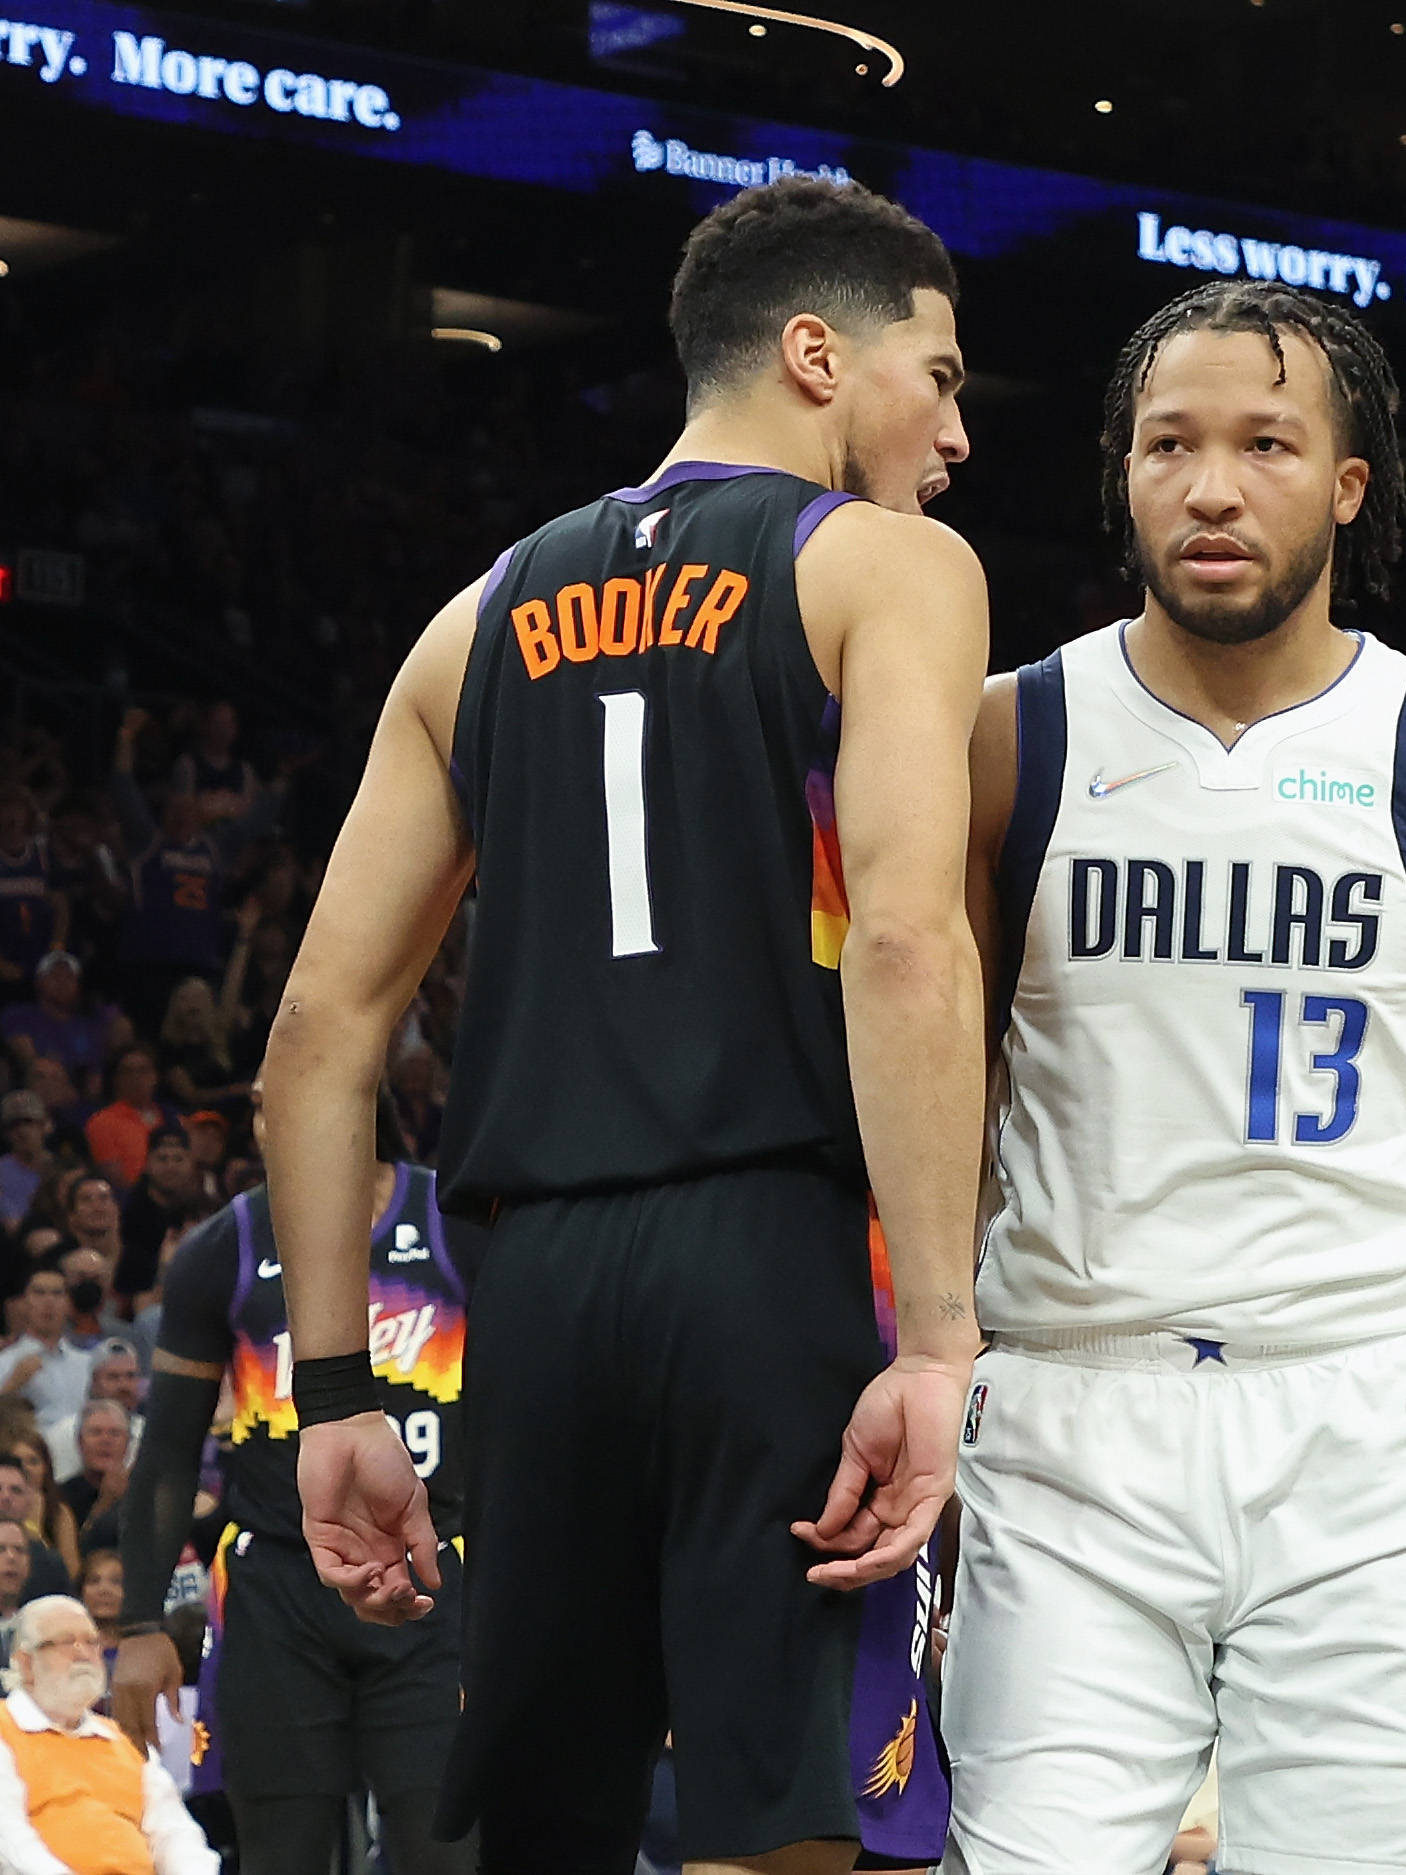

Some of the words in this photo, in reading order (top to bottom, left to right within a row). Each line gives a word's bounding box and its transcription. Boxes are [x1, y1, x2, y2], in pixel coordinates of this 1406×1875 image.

[111, 30, 260, 106] More
[264, 69, 401, 131] care.
[1137, 211, 1239, 274] Less
[1240, 238, 1391, 308] worry.
[511, 562, 748, 680] BOOKER
[598, 691, 660, 958] 1
[1277, 768, 1376, 808] chime
[1067, 857, 1384, 973] DALLAS
[1240, 986, 1371, 1147] 13
